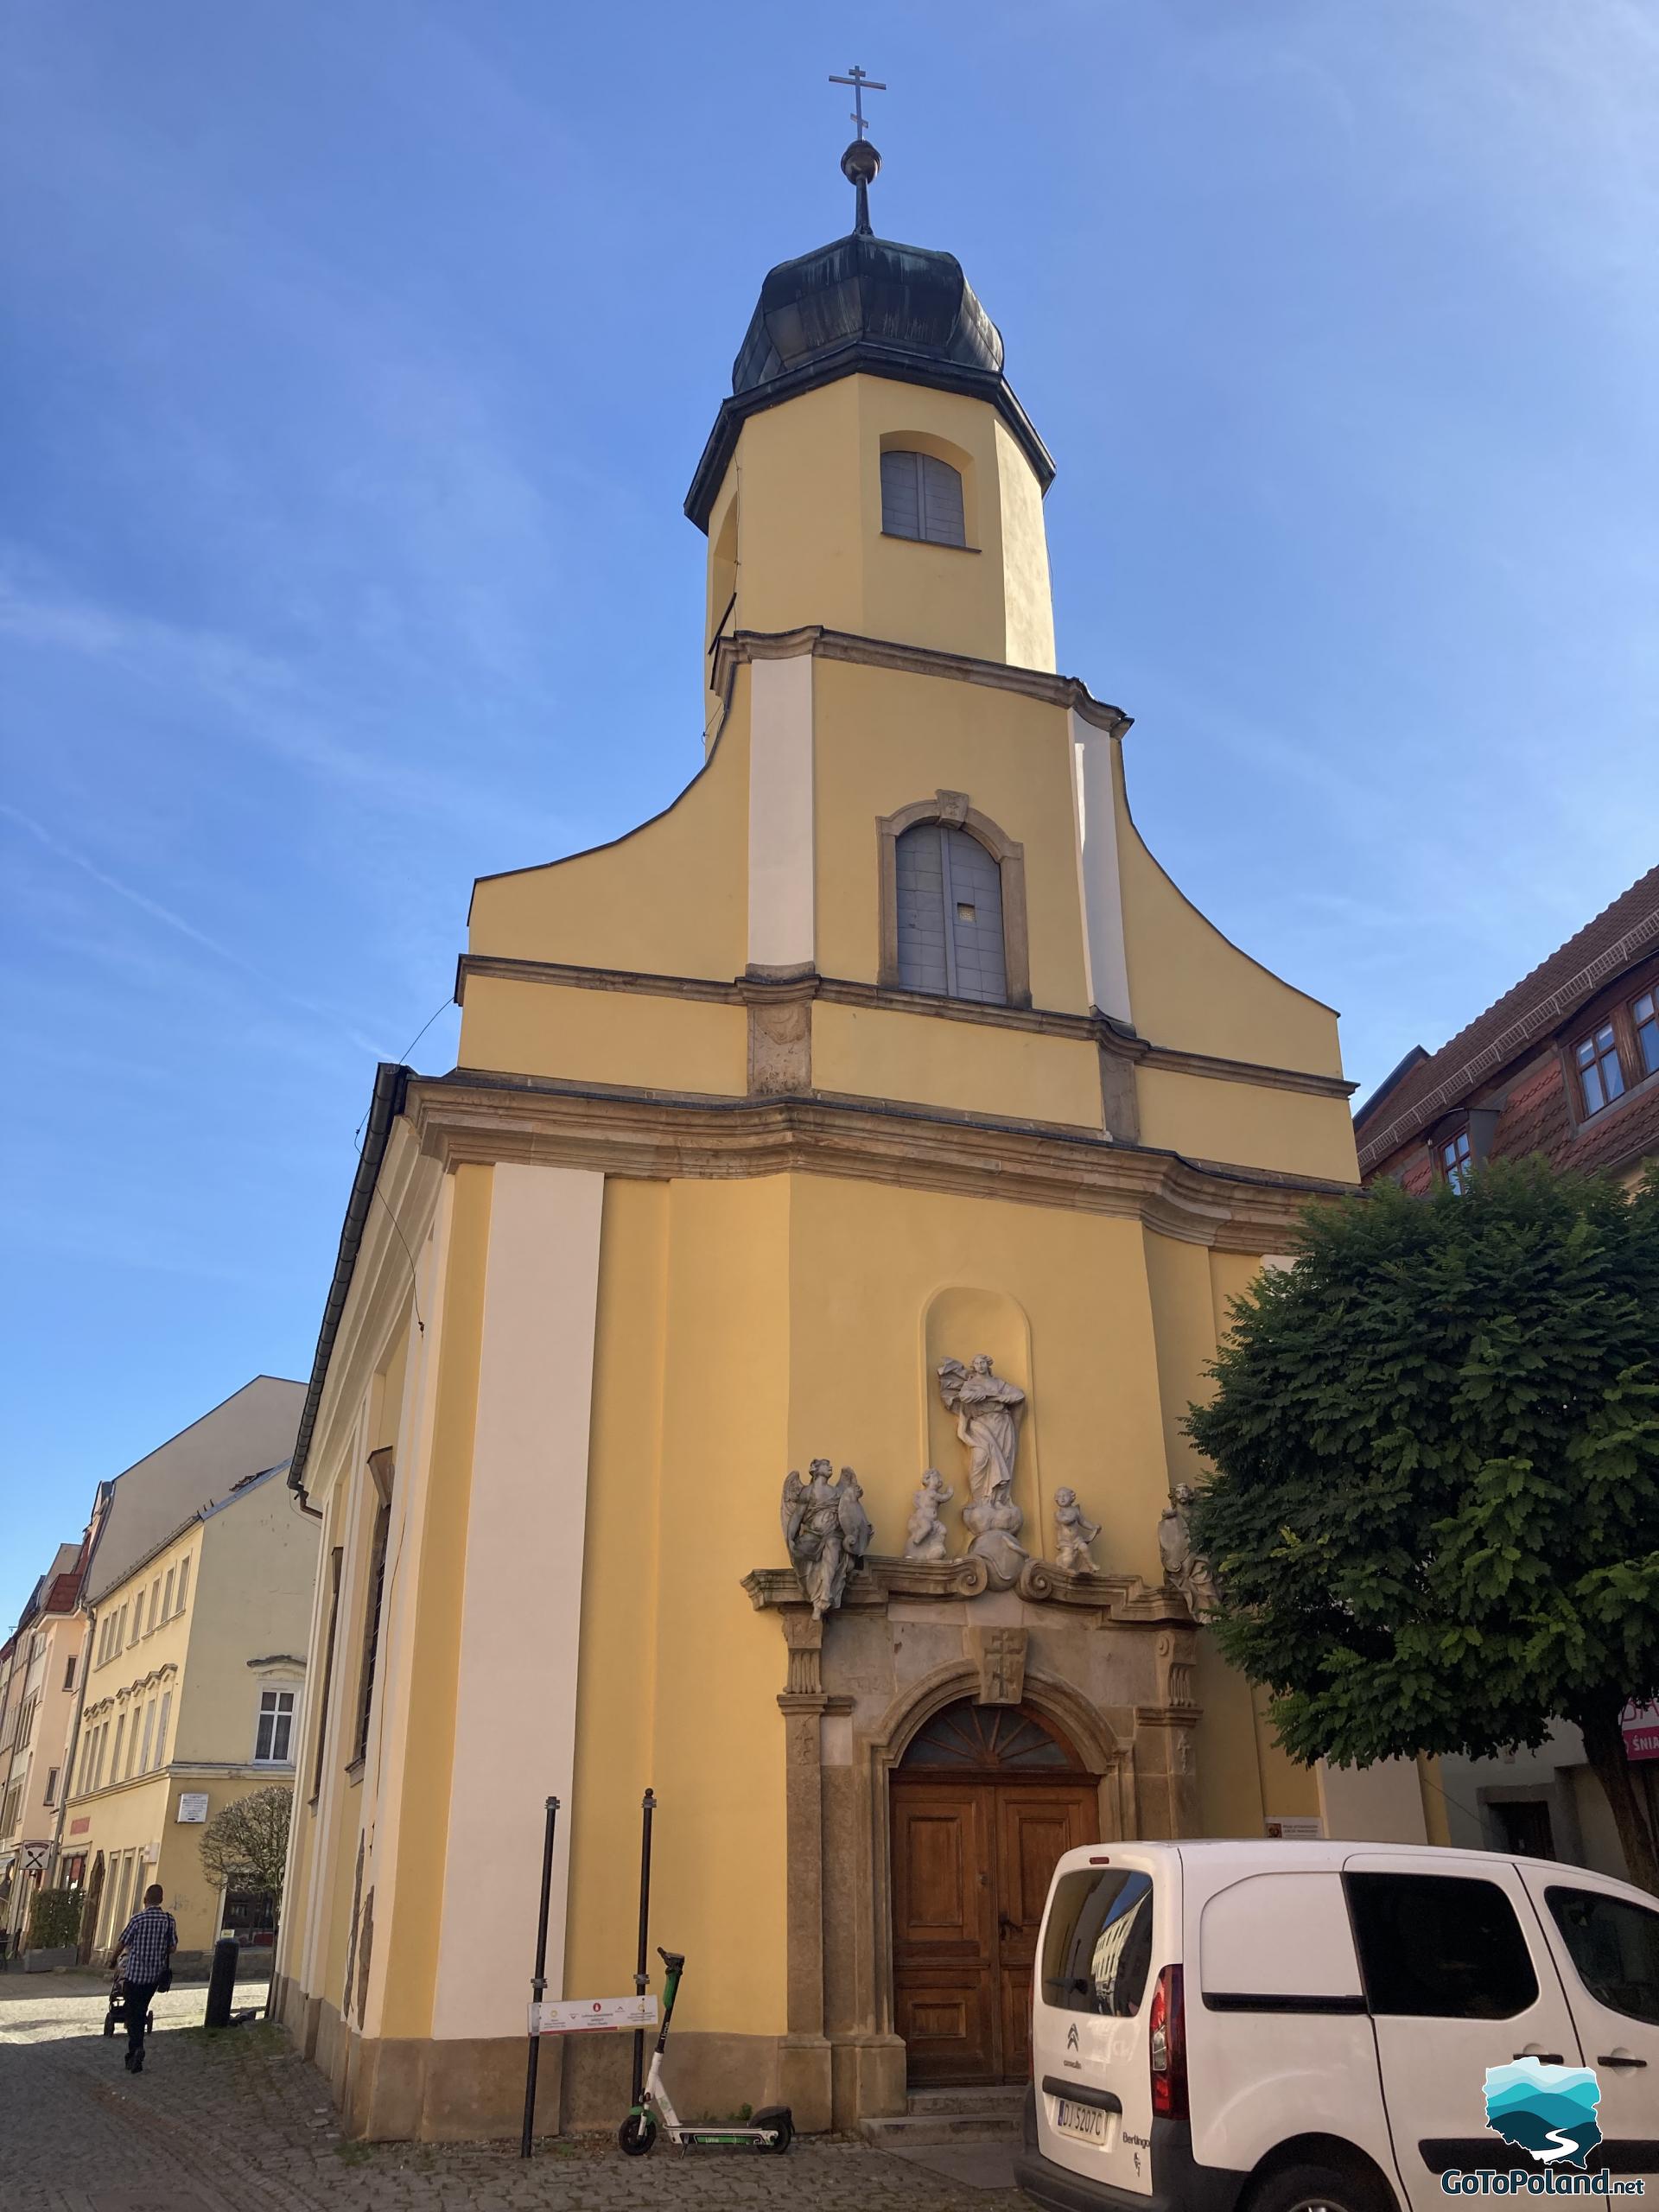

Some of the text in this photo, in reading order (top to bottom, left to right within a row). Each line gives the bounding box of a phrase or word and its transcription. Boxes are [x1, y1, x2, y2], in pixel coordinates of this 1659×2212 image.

[1063, 2103, 1103, 2136] DJ 5207C
[1122, 2133, 1150, 2149] Berlingo
